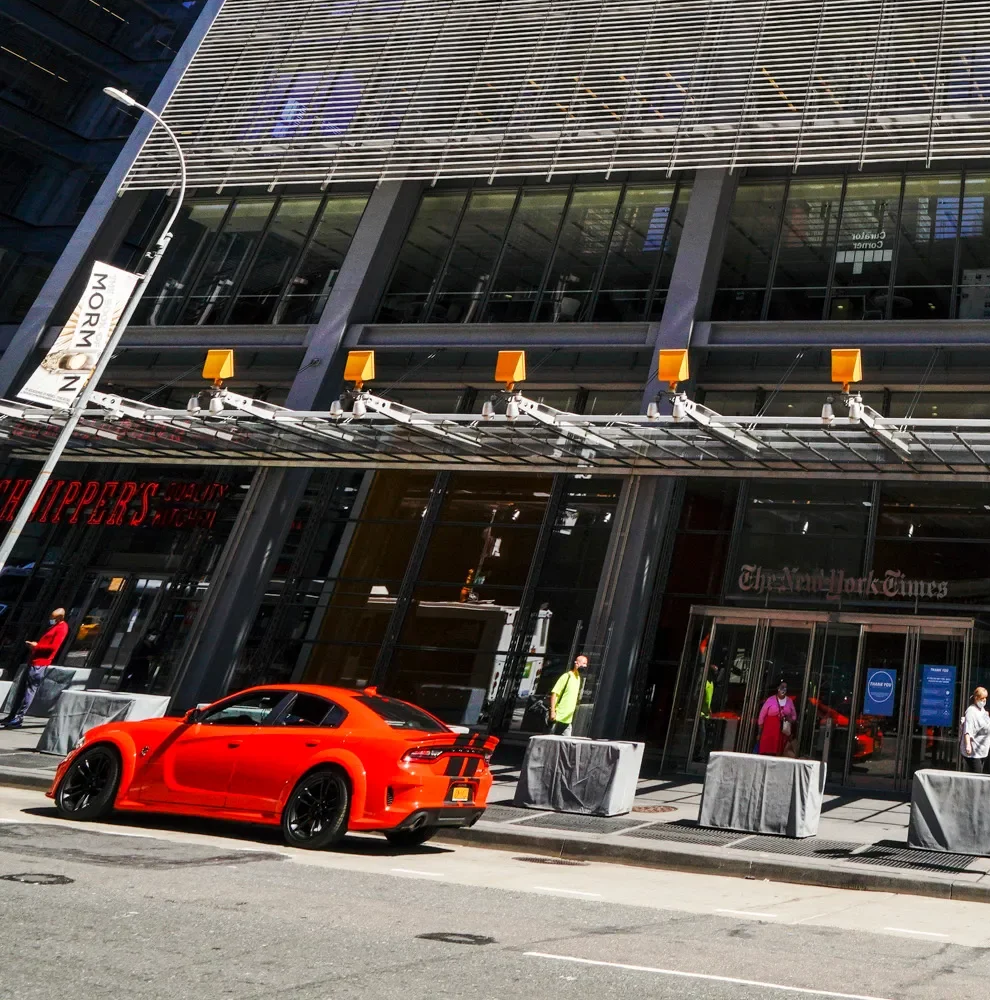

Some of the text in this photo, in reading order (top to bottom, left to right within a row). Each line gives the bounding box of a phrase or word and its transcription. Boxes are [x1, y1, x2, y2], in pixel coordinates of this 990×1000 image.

[738, 564, 949, 600] The New York Times
